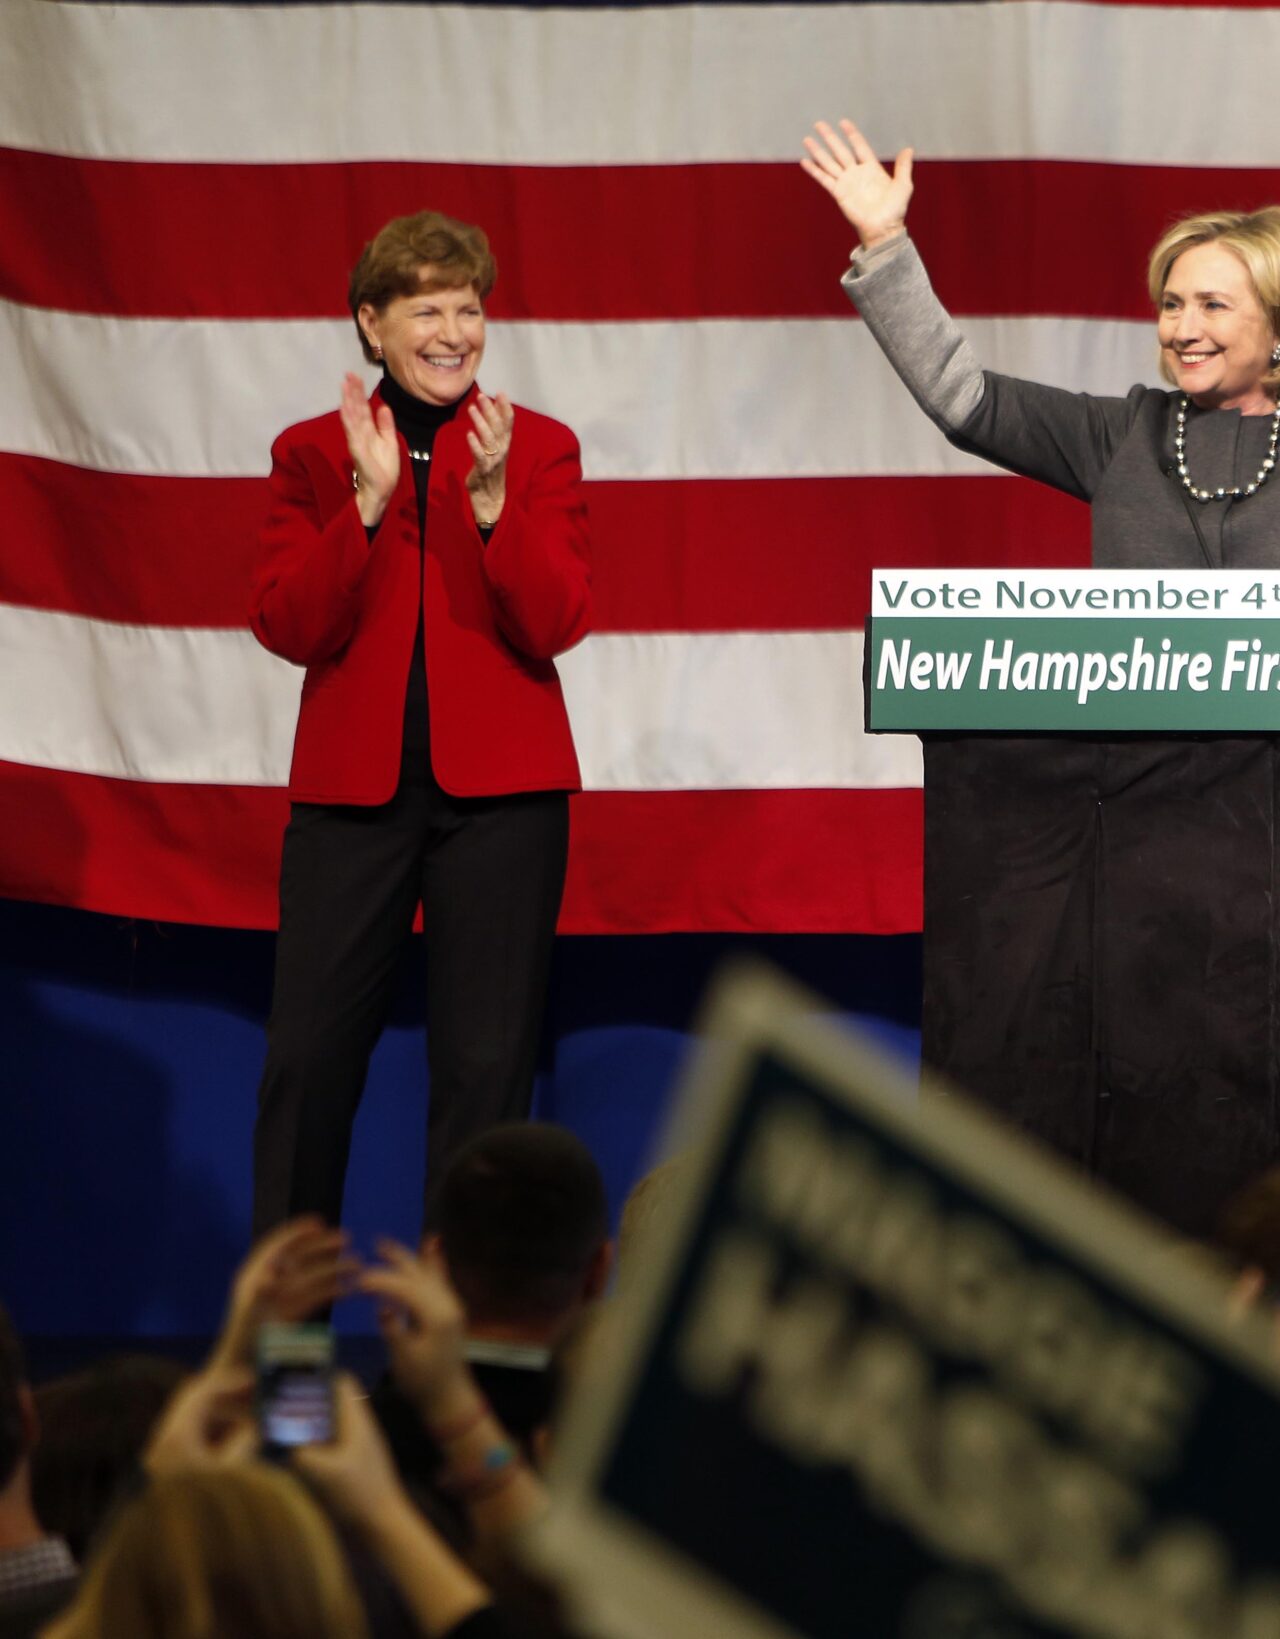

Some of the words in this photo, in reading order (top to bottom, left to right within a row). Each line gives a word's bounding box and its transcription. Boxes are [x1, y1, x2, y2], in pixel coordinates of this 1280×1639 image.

[879, 580, 981, 609] Vote
[996, 579, 1229, 610] November
[876, 638, 971, 691] New
[979, 637, 1210, 704] Hampshire
